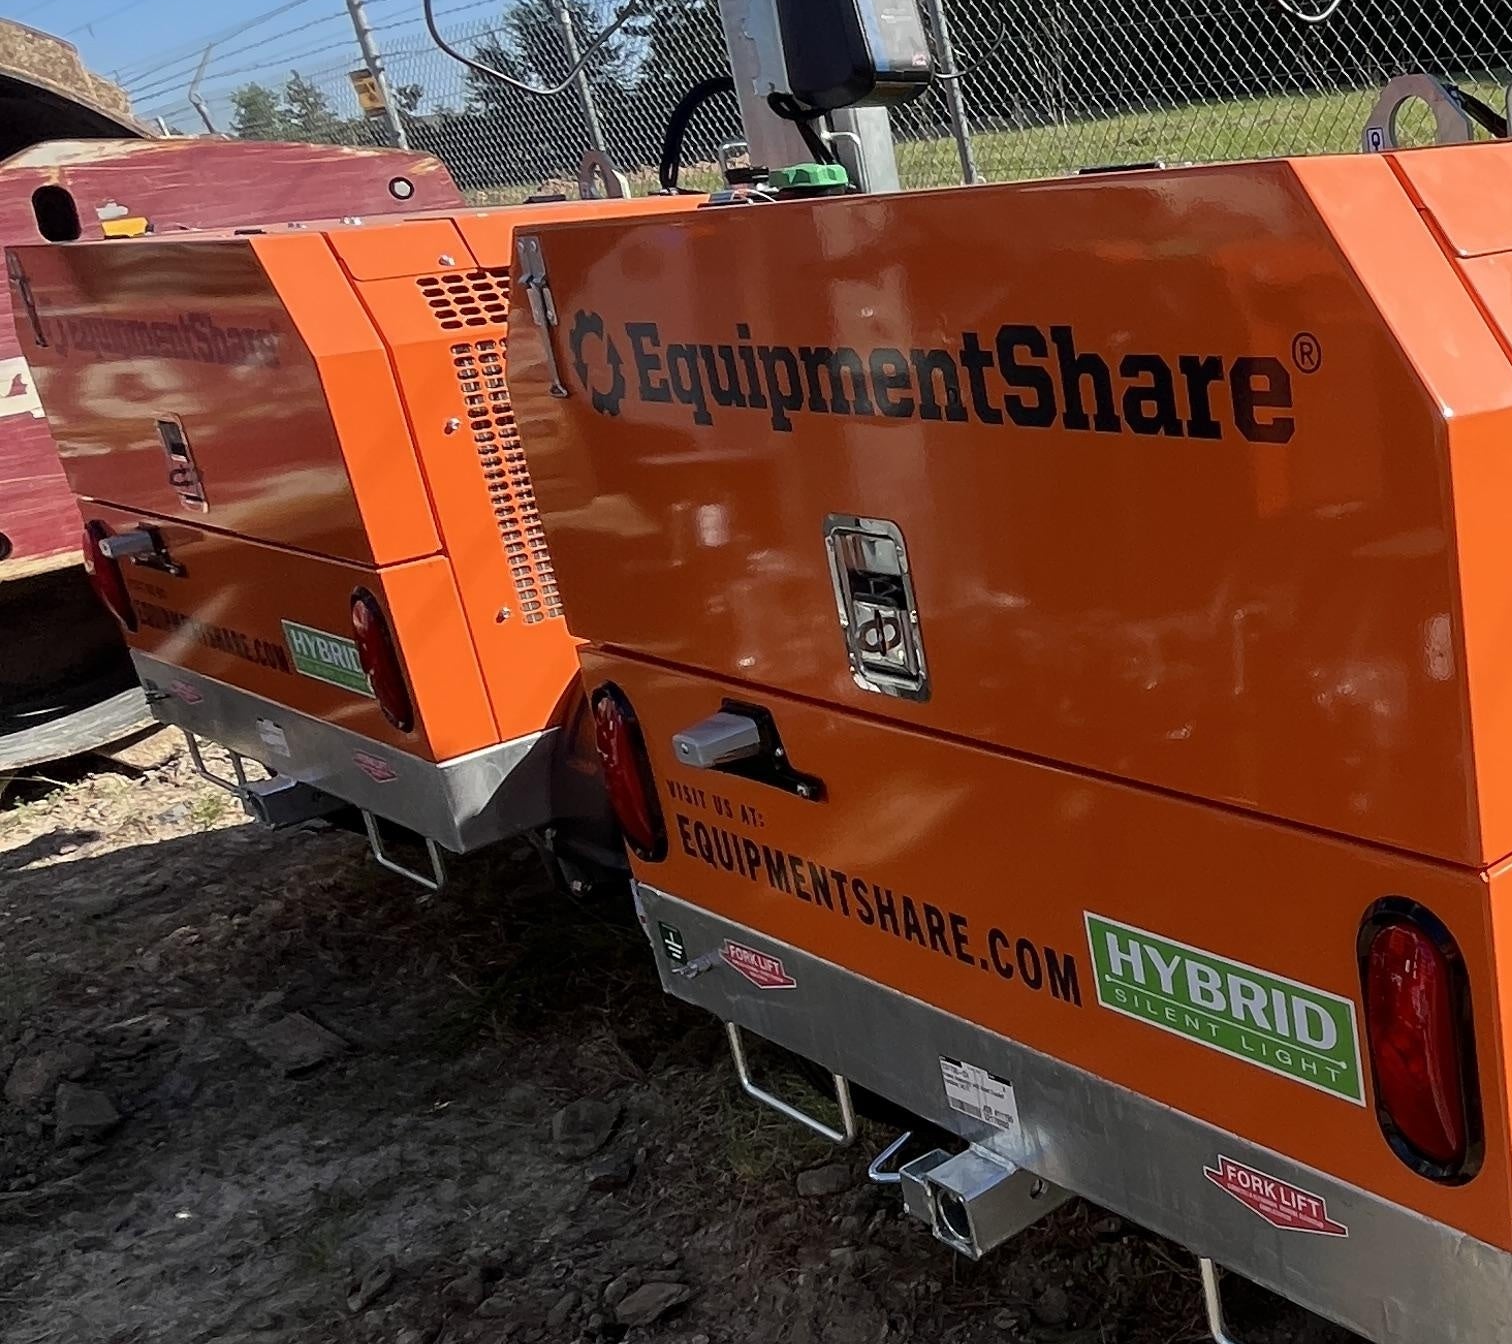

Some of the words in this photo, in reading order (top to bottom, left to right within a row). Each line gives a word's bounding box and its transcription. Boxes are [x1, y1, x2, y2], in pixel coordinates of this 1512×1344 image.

[288, 628, 364, 673] HYBRID
[665, 778, 707, 809] VISIT
[712, 794, 734, 819] US
[676, 813, 1083, 1008] EQUIPMENTSHARE.COM
[729, 944, 759, 967] FORK
[757, 955, 780, 976] LIFT
[1105, 931, 1338, 1050] HYBRID
[1114, 987, 1221, 1038] SILENT
[1240, 1034, 1341, 1083] LIGHT
[1226, 1165, 1278, 1201] FORK
[1279, 1186, 1321, 1218] LIFT
